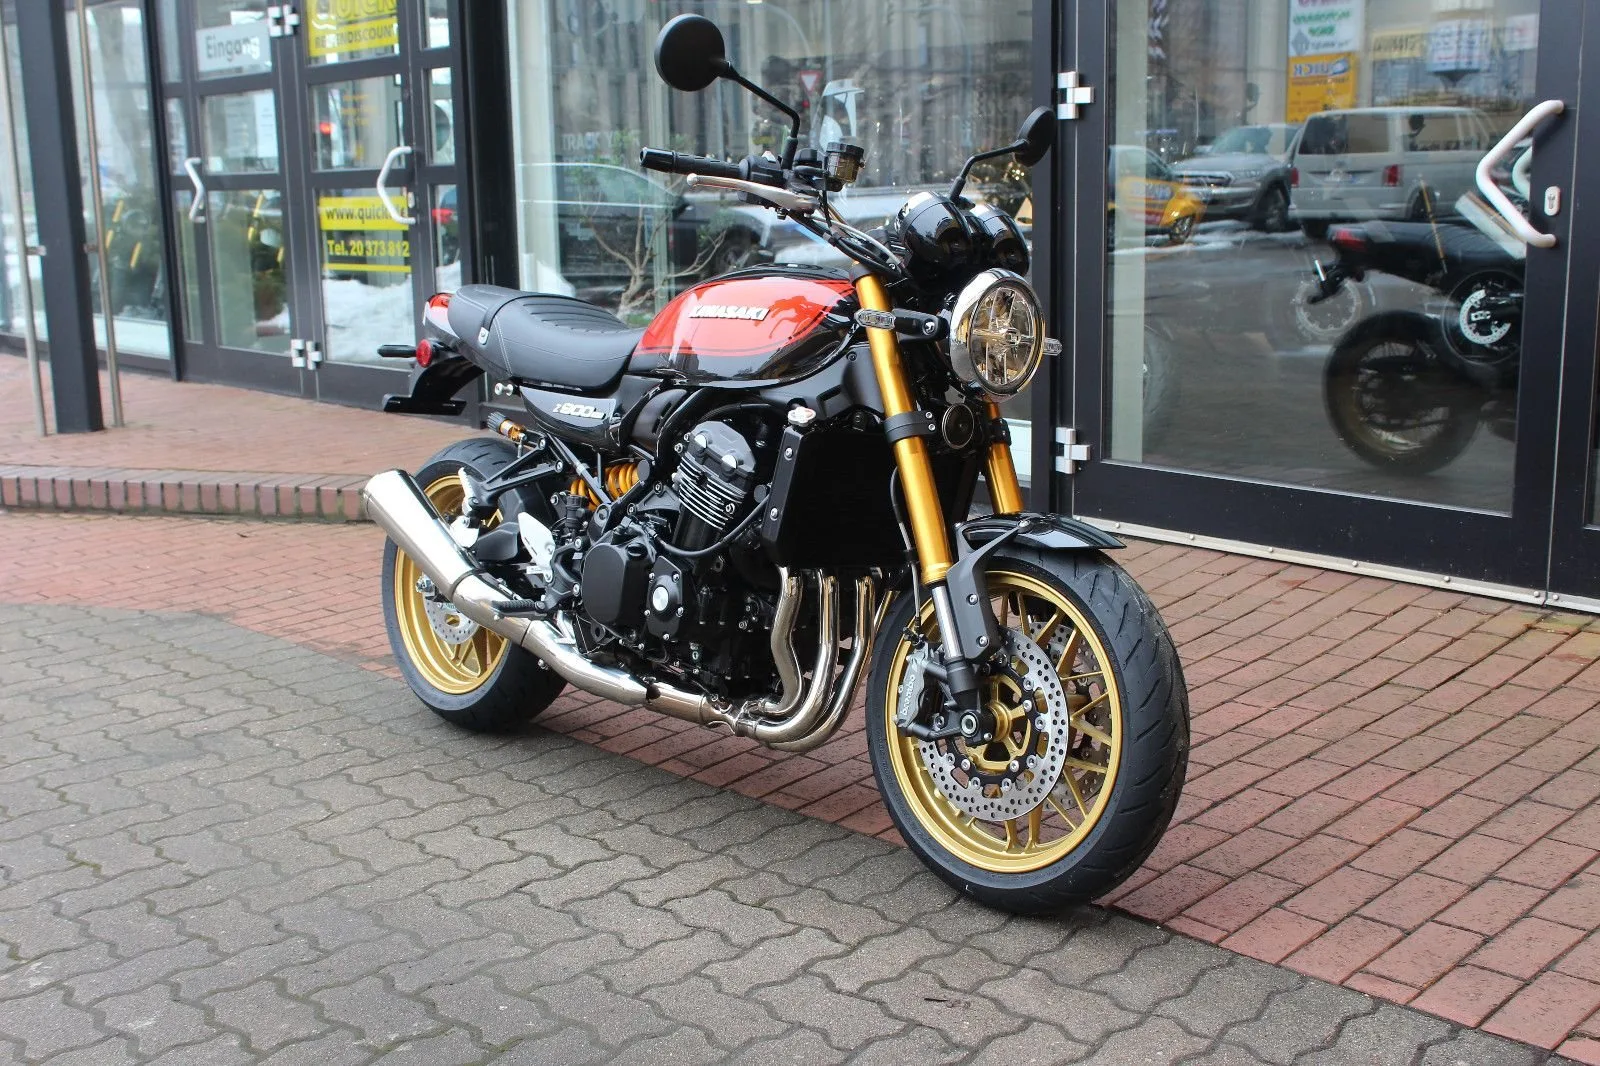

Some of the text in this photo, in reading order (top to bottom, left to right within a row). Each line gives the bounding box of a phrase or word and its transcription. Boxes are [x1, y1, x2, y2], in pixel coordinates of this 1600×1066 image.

[205, 34, 260, 62] Eingang
[327, 240, 410, 257] Tel. 20 373 812
[688, 305, 770, 321] KAWASAKI
[901, 674, 915, 716] brembo
